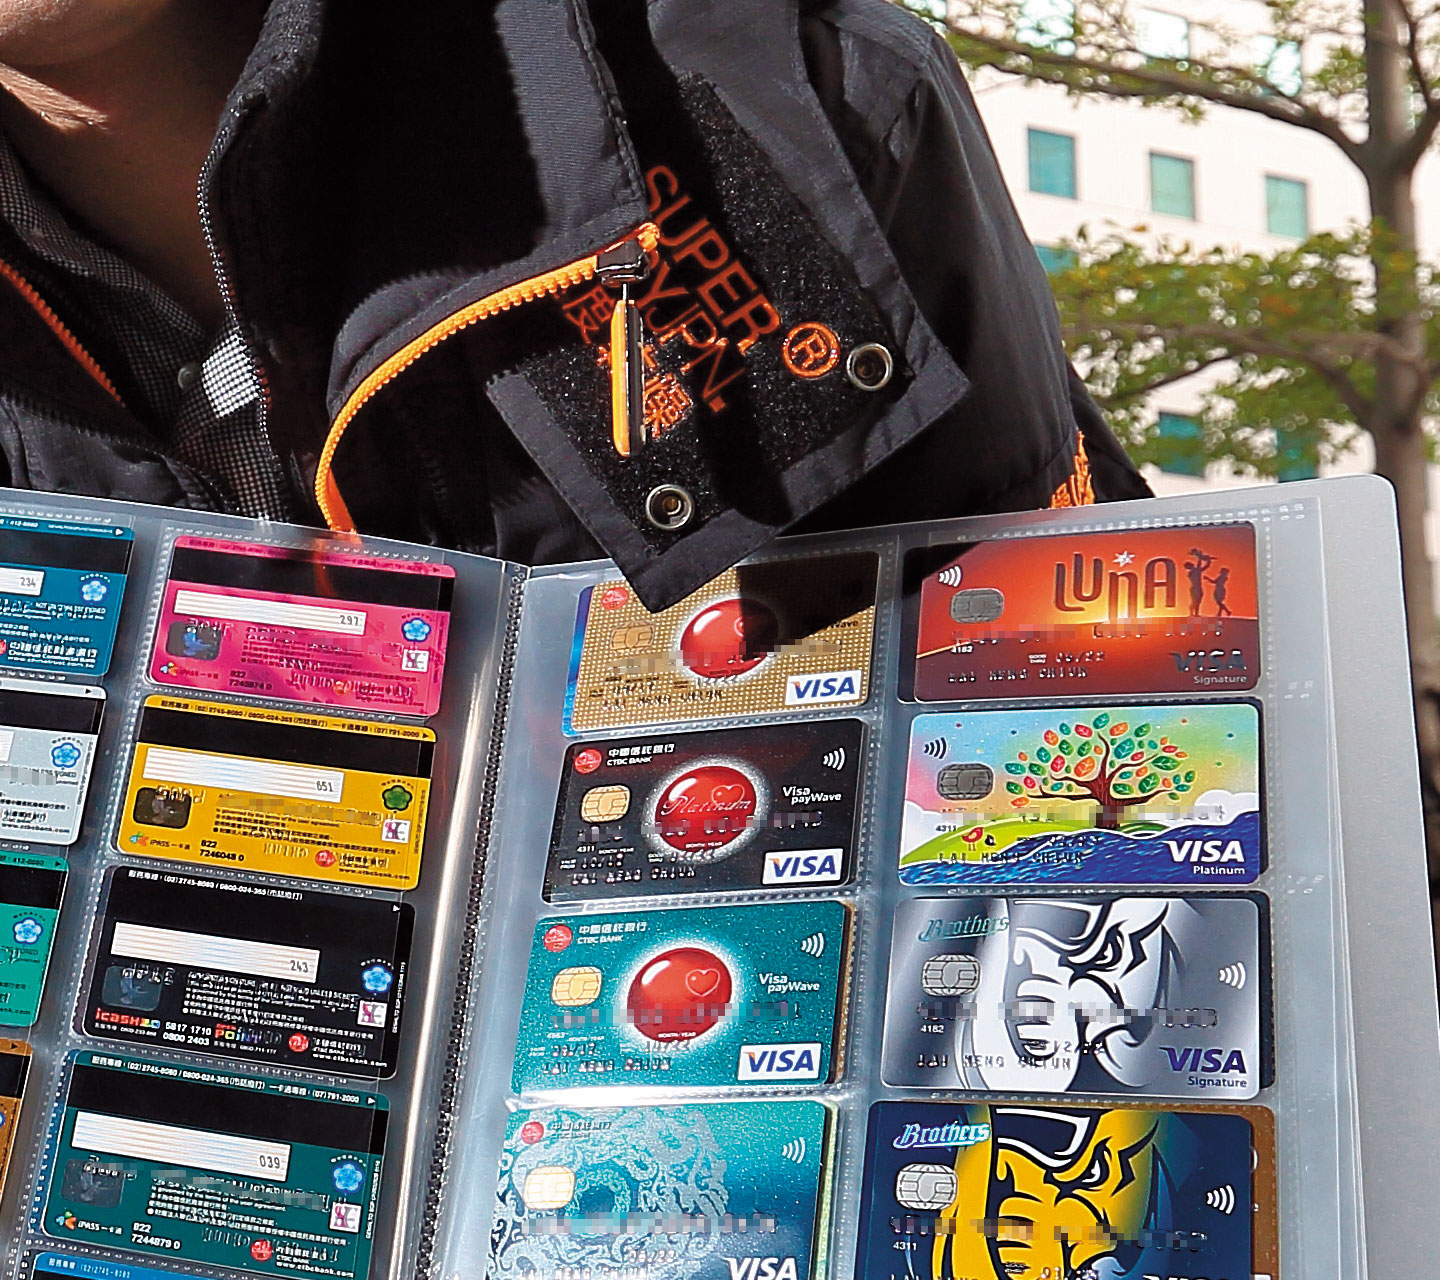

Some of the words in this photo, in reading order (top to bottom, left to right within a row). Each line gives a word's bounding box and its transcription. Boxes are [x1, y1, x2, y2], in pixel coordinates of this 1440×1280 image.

[645, 165, 782, 357] SUPER
[19, 577, 37, 588] 234
[339, 614, 360, 626] 297
[1171, 650, 1247, 672] VISA
[1193, 675, 1247, 685] Signature
[792, 676, 856, 699] VISA
[783, 786, 810, 797] Visa
[792, 792, 842, 805] payWave
[660, 793, 752, 817] Platinum
[1165, 840, 1245, 863] VISA
[770, 855, 837, 878] VISA
[1193, 865, 1246, 876] Platinum
[919, 916, 1010, 942] Brothers
[288, 959, 309, 973] 243
[759, 973, 787, 986] Visa
[768, 981, 820, 994] payWave
[921, 1024, 944, 1033] 4182
[748, 1050, 815, 1072] VISA
[1159, 1047, 1248, 1074] VISA
[1188, 1076, 1248, 1089] Signature
[893, 1122, 991, 1150] Brothers
[259, 1155, 281, 1169] 039
[893, 1241, 917, 1251] 4311
